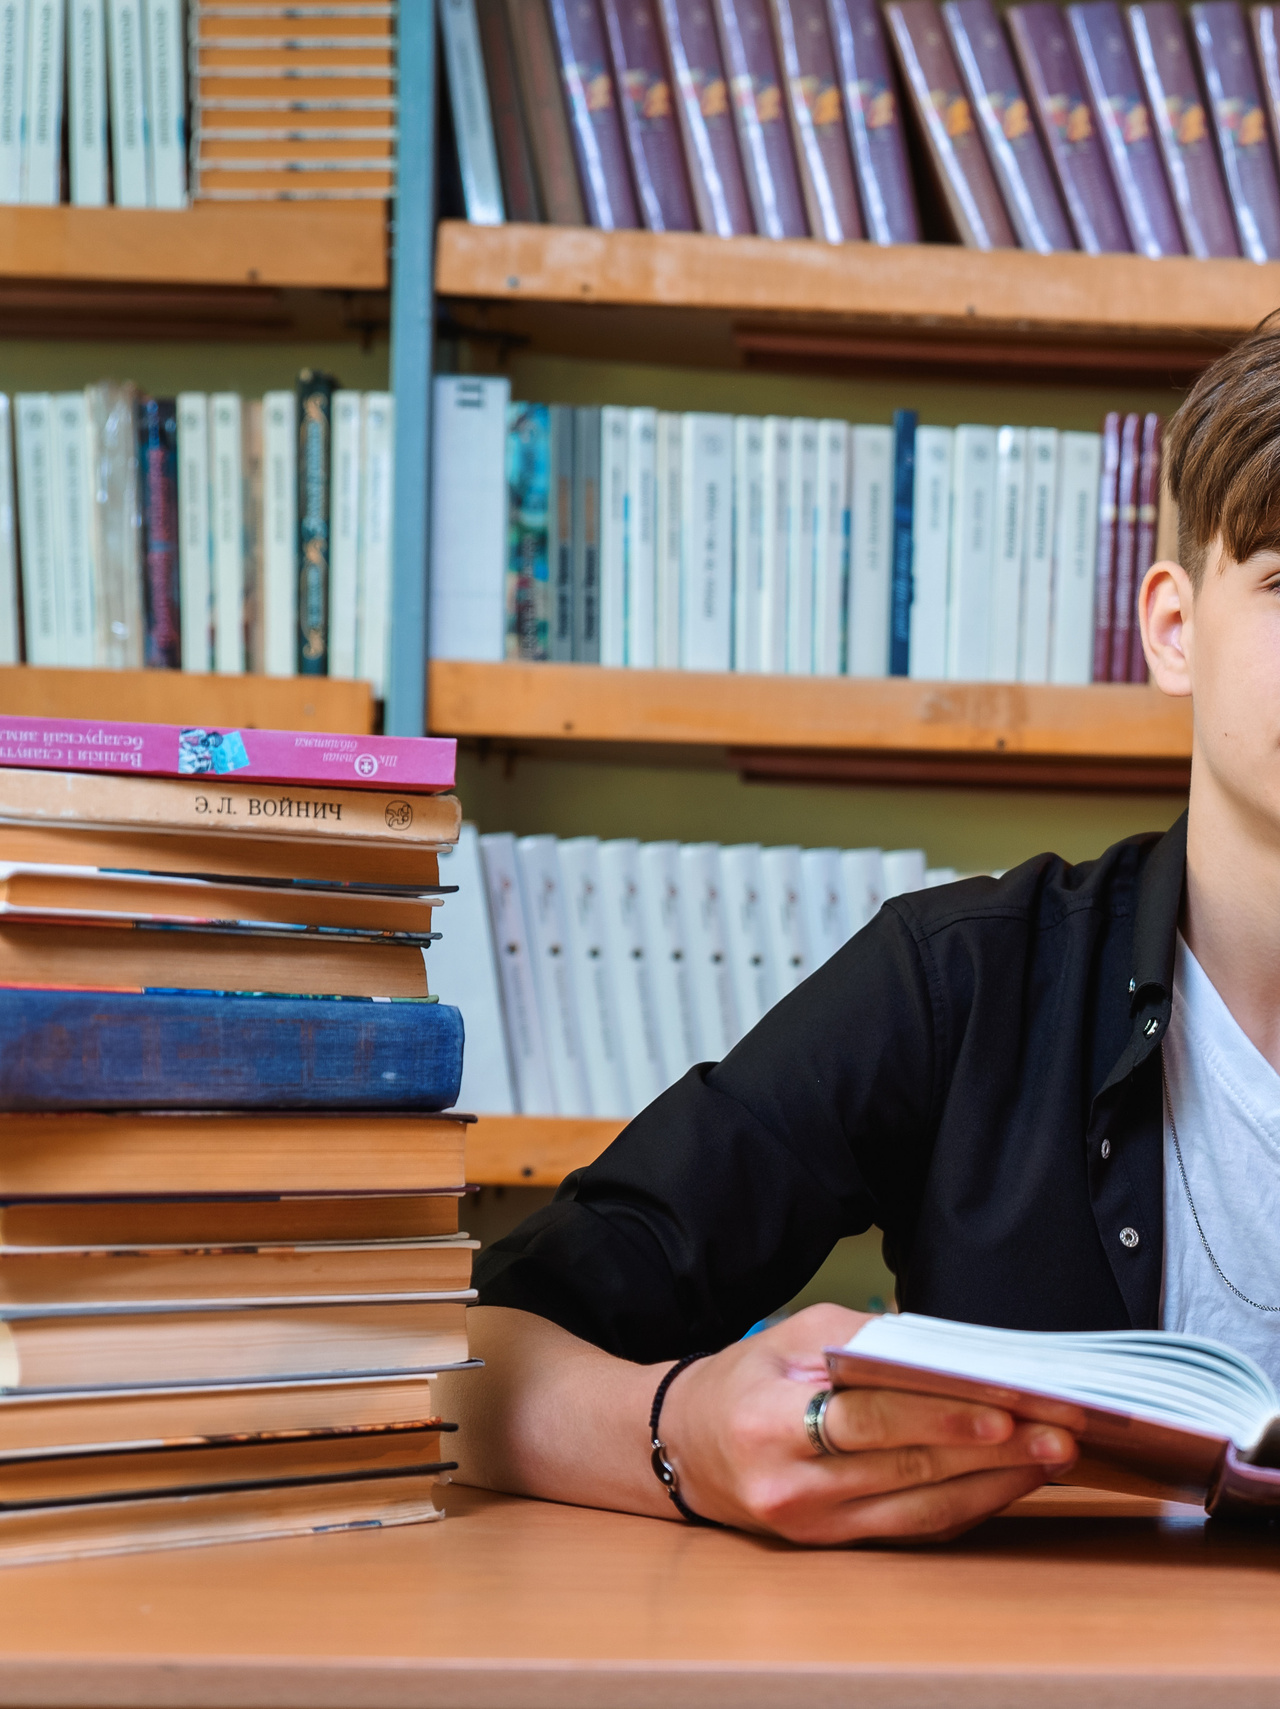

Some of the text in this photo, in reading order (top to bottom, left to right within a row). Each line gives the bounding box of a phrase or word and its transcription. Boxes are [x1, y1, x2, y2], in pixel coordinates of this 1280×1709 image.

[43, 729, 143, 751] беларускай
[294, 737, 358, 751] бібліятэка
[78, 749, 142, 768] Вялікія
[247, 797, 343, 821] ВОЙНИЧ
